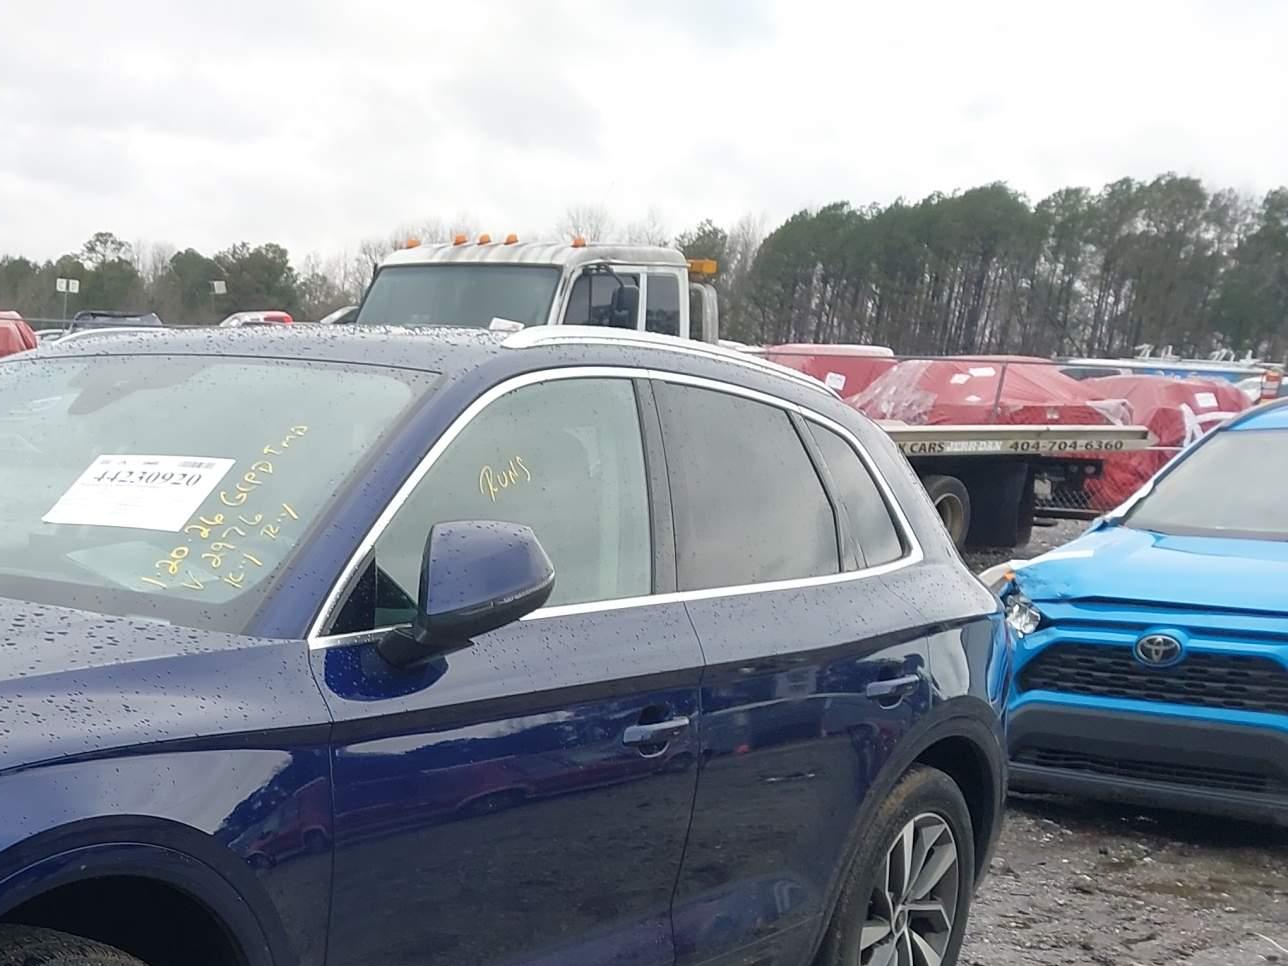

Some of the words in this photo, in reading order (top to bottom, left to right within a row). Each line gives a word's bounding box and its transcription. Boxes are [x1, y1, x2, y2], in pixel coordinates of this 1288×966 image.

[909, 442, 945, 454] CARS
[1009, 440, 1124, 453] 404-704-6360
[92, 470, 202, 487] 44230920
